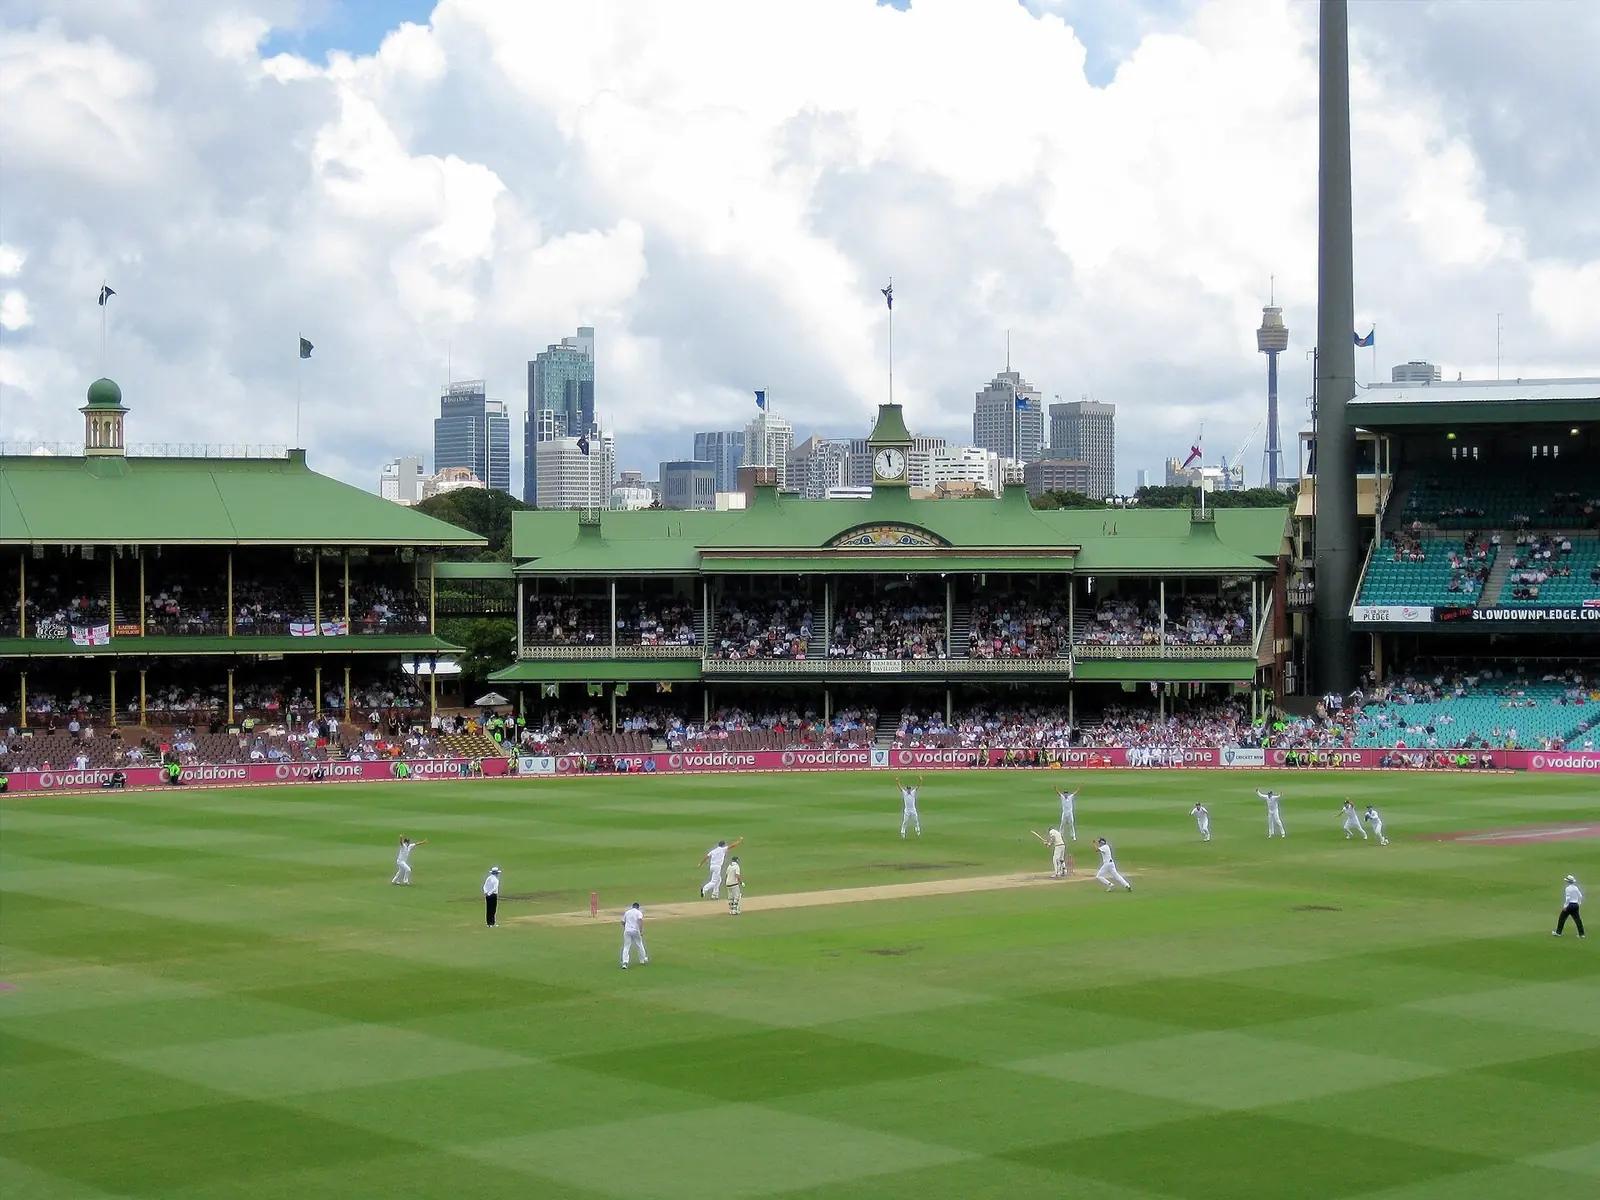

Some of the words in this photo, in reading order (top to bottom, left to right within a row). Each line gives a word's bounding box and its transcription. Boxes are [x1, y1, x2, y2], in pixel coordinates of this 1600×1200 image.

[1363, 613, 1390, 621] PLEDGE
[684, 752, 756, 766] vodafone
[797, 750, 868, 764] vodafone
[914, 749, 976, 763] vodafon
